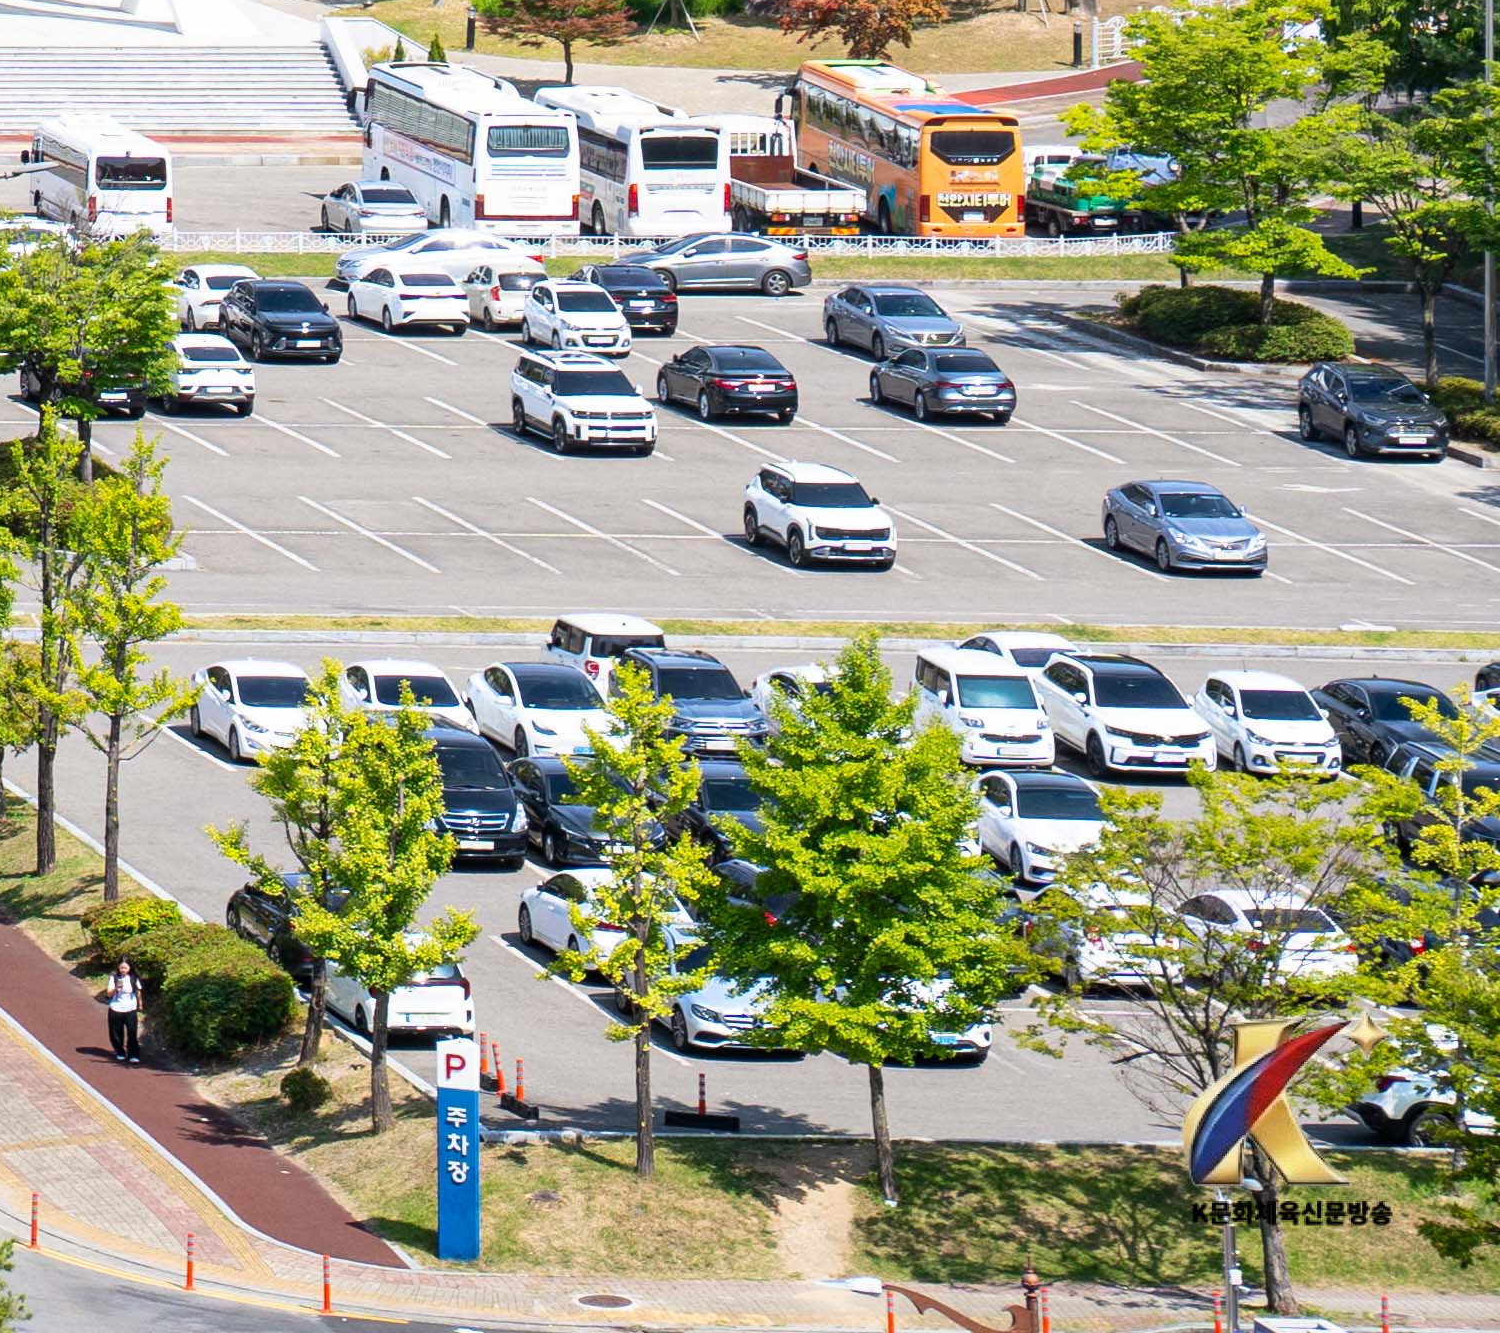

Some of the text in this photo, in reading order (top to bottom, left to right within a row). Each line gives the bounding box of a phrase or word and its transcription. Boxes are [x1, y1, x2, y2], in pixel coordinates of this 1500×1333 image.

[937, 192, 1011, 208] 천안시티투어
[445, 1053, 467, 1079] P
[446, 1106, 470, 1184] 주차장
